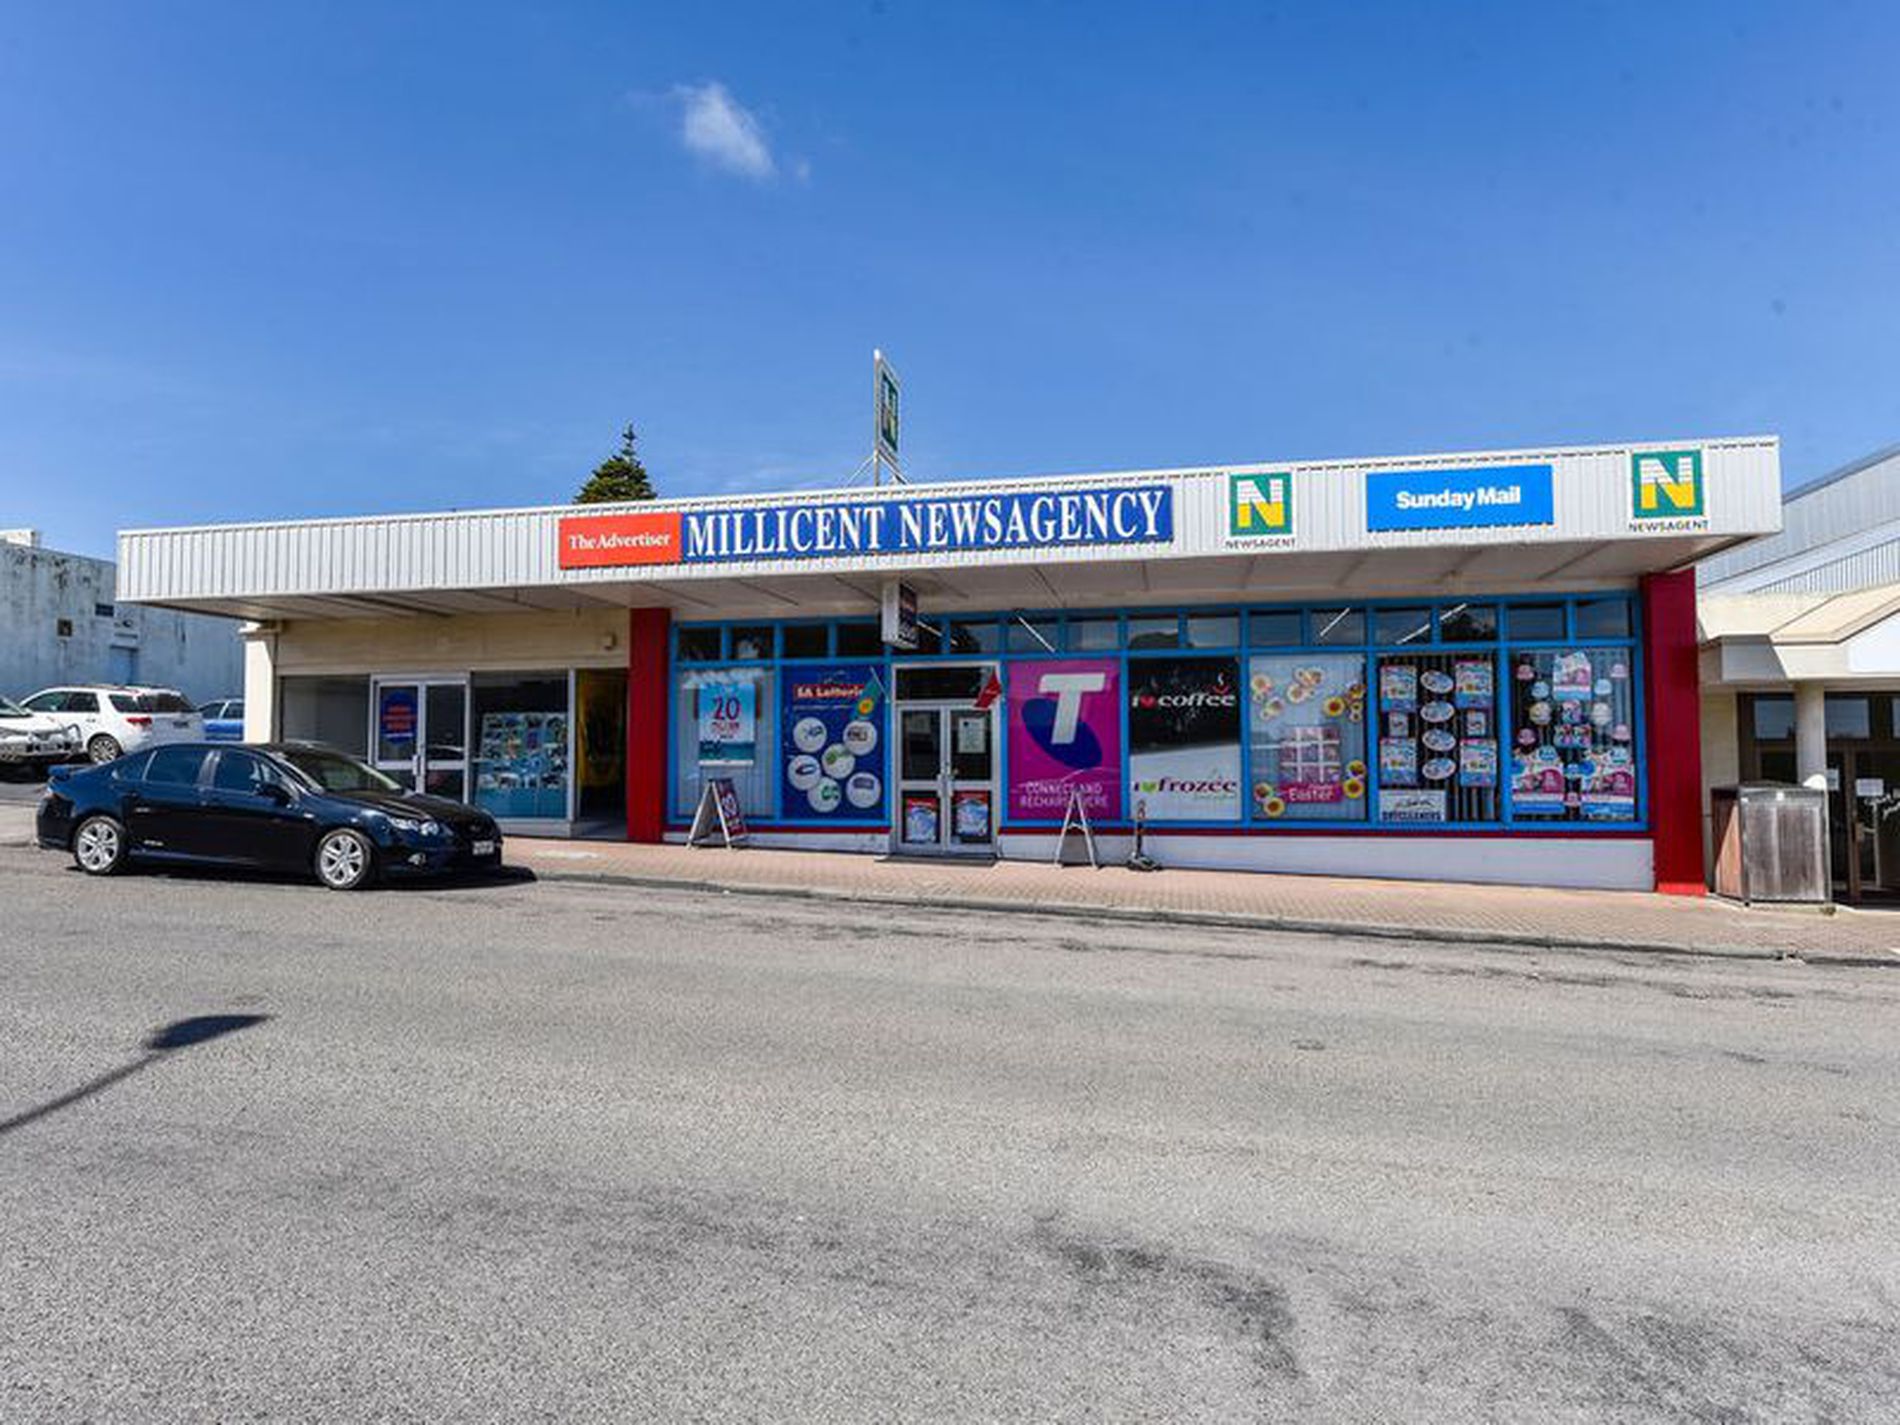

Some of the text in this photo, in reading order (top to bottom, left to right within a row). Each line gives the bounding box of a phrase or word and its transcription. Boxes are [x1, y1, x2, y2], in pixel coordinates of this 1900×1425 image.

[1639, 457, 1696, 510] N
[1236, 479, 1285, 528] N
[1396, 486, 1521, 510] Sunday Mail
[687, 490, 1164, 557] MILLICENT NEWSAGENCY
[1628, 520, 1708, 532] NEWSAGENT
[569, 531, 670, 550] The Advertiser
[1225, 538, 1296, 549] NEWSAGENT
[713, 696, 741, 720] 20
[1038, 672, 1106, 745] T
[1158, 692, 1236, 707] coffee
